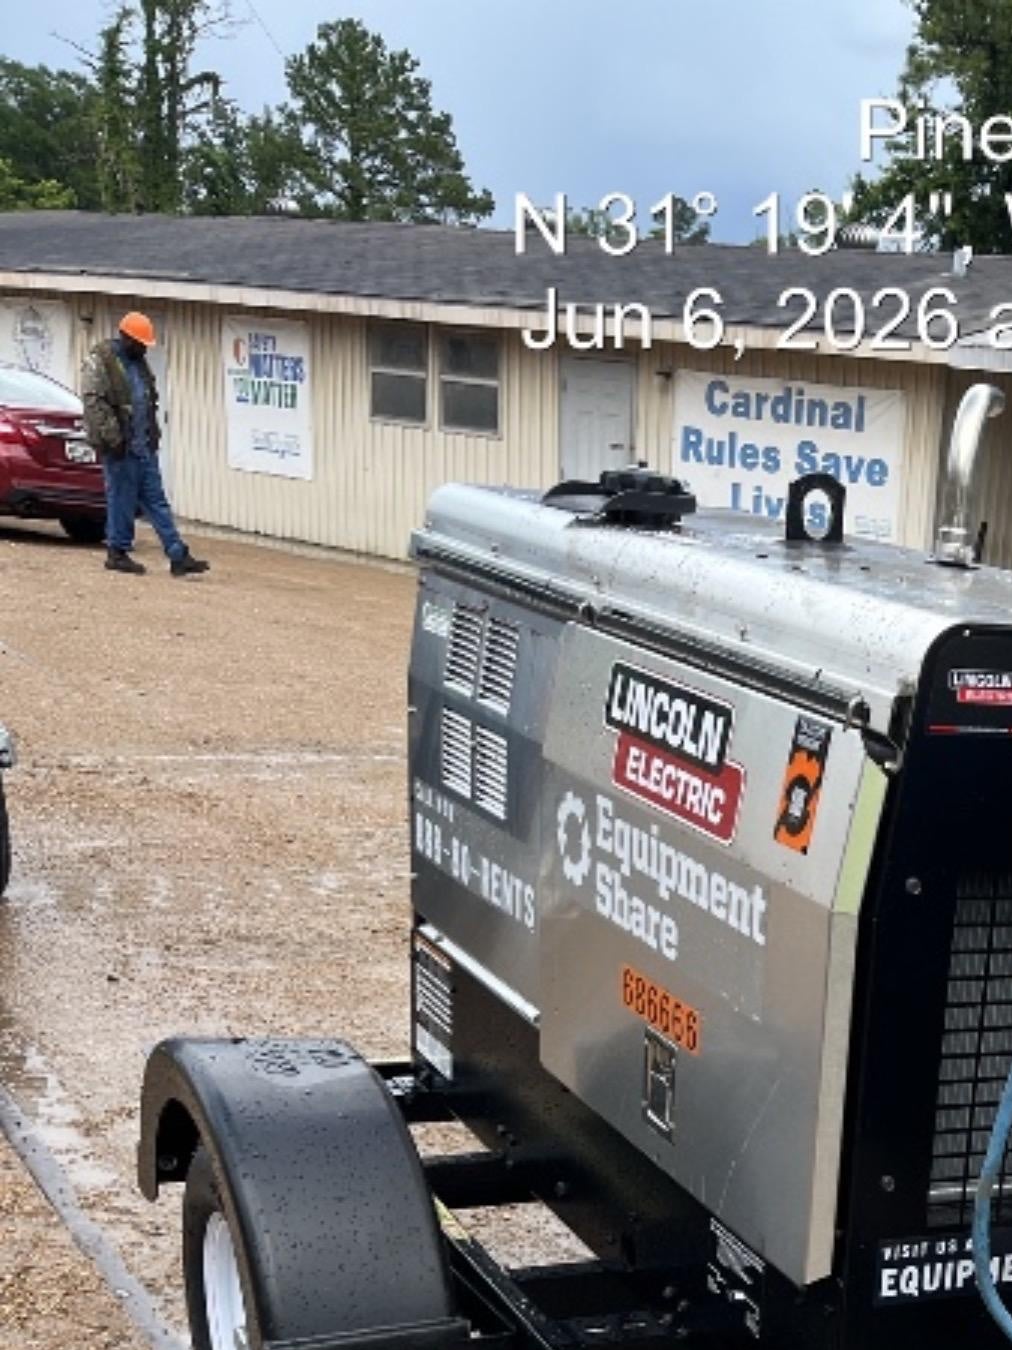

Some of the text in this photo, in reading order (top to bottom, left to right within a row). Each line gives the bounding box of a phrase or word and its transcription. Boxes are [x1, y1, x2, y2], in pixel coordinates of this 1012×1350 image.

[704, 379, 866, 432] Cardinal
[681, 425, 889, 487] Rules Save
[731, 483, 826, 530] Livs
[611, 673, 725, 766] LINCOLN
[625, 746, 726, 826] ELECTRIC
[596, 794, 767, 945] Equipment
[596, 861, 679, 961] Share
